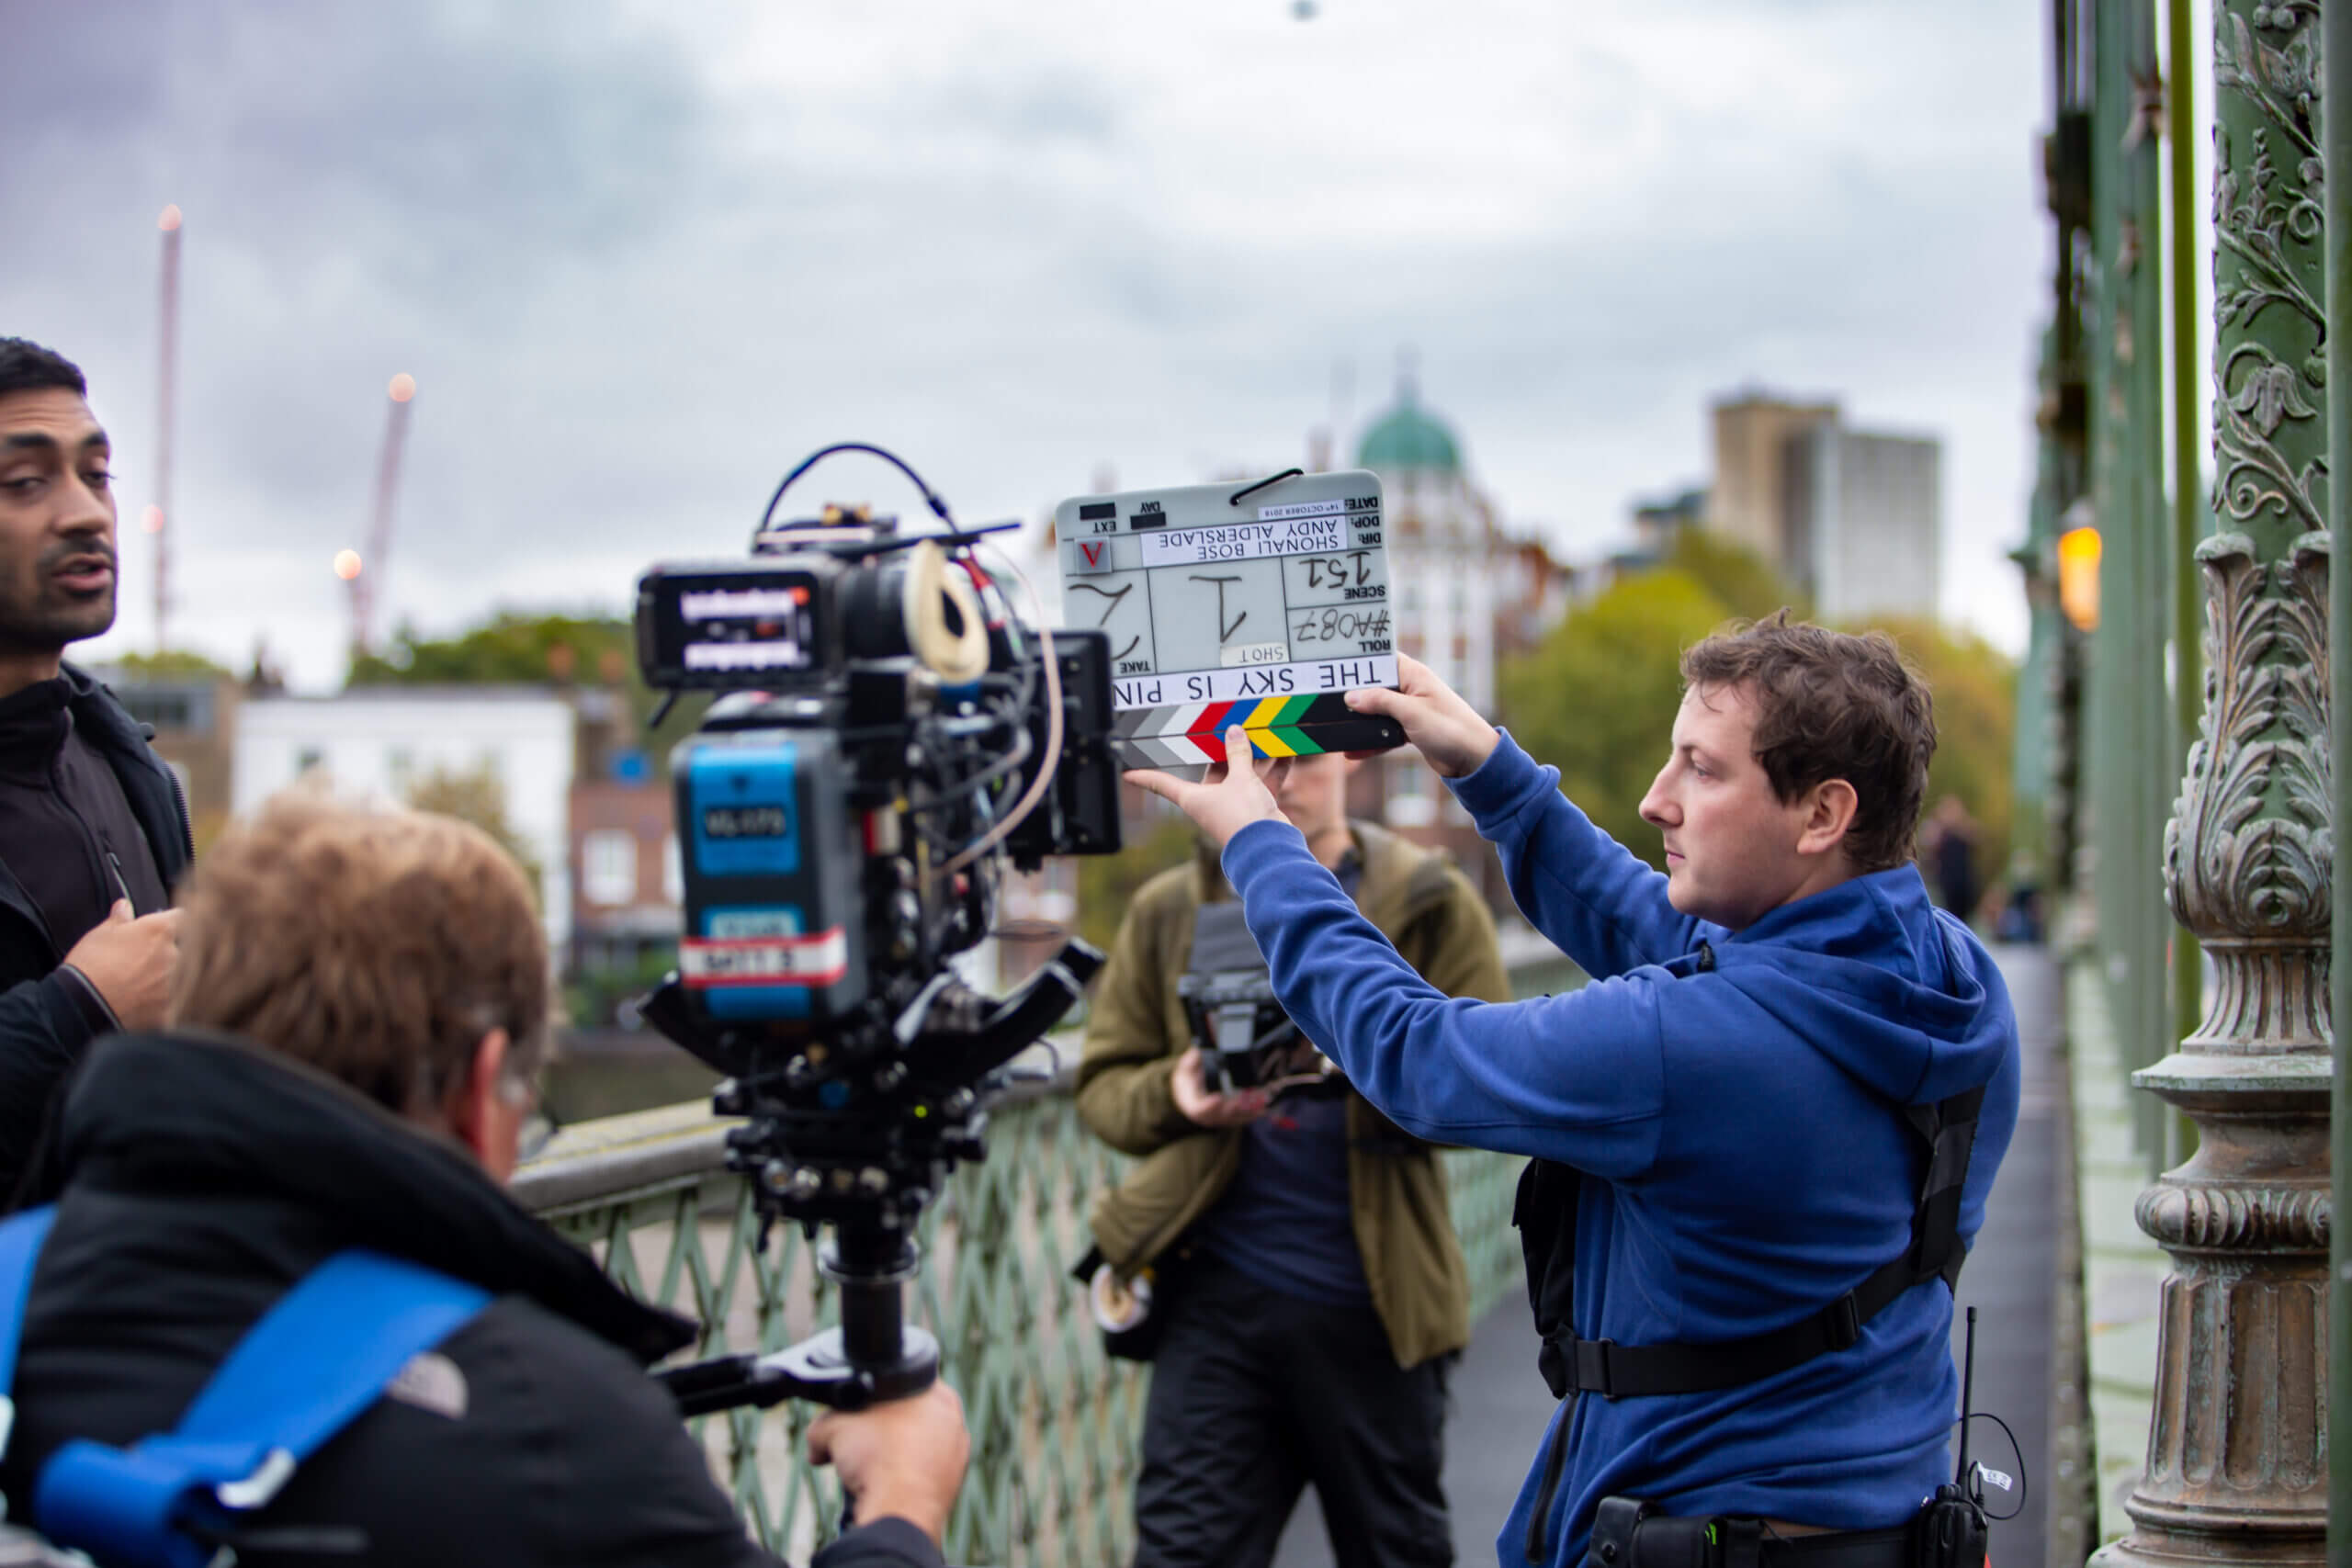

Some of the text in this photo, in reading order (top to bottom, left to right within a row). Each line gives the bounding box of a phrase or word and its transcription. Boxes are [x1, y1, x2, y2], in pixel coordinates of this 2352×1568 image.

[1140, 501, 1161, 513] DAY
[1285, 504, 1324, 514] OCTOBER
[1344, 497, 1379, 511] DATE:
[1265, 509, 1283, 517] 2018
[1092, 521, 1116, 533] EXT
[1350, 515, 1381, 529] DOP:
[1159, 519, 1337, 548] ANDY ALDERSLADE
[1358, 533, 1381, 545] DIR:
[1080, 542, 1103, 568] A
[1197, 535, 1339, 560] SHONALI BOSE
[1298, 551, 1372, 589] 151
[1344, 585, 1386, 600] SCENE
[1189, 575, 1247, 643] 1
[1358, 639, 1391, 653] ROLL
[1240, 646, 1283, 664] SHOT
[1119, 660, 1150, 673] TAKE
[1238, 668, 1295, 695] SKY
[1318, 660, 1382, 689] THE
[1187, 675, 1213, 701] IS
